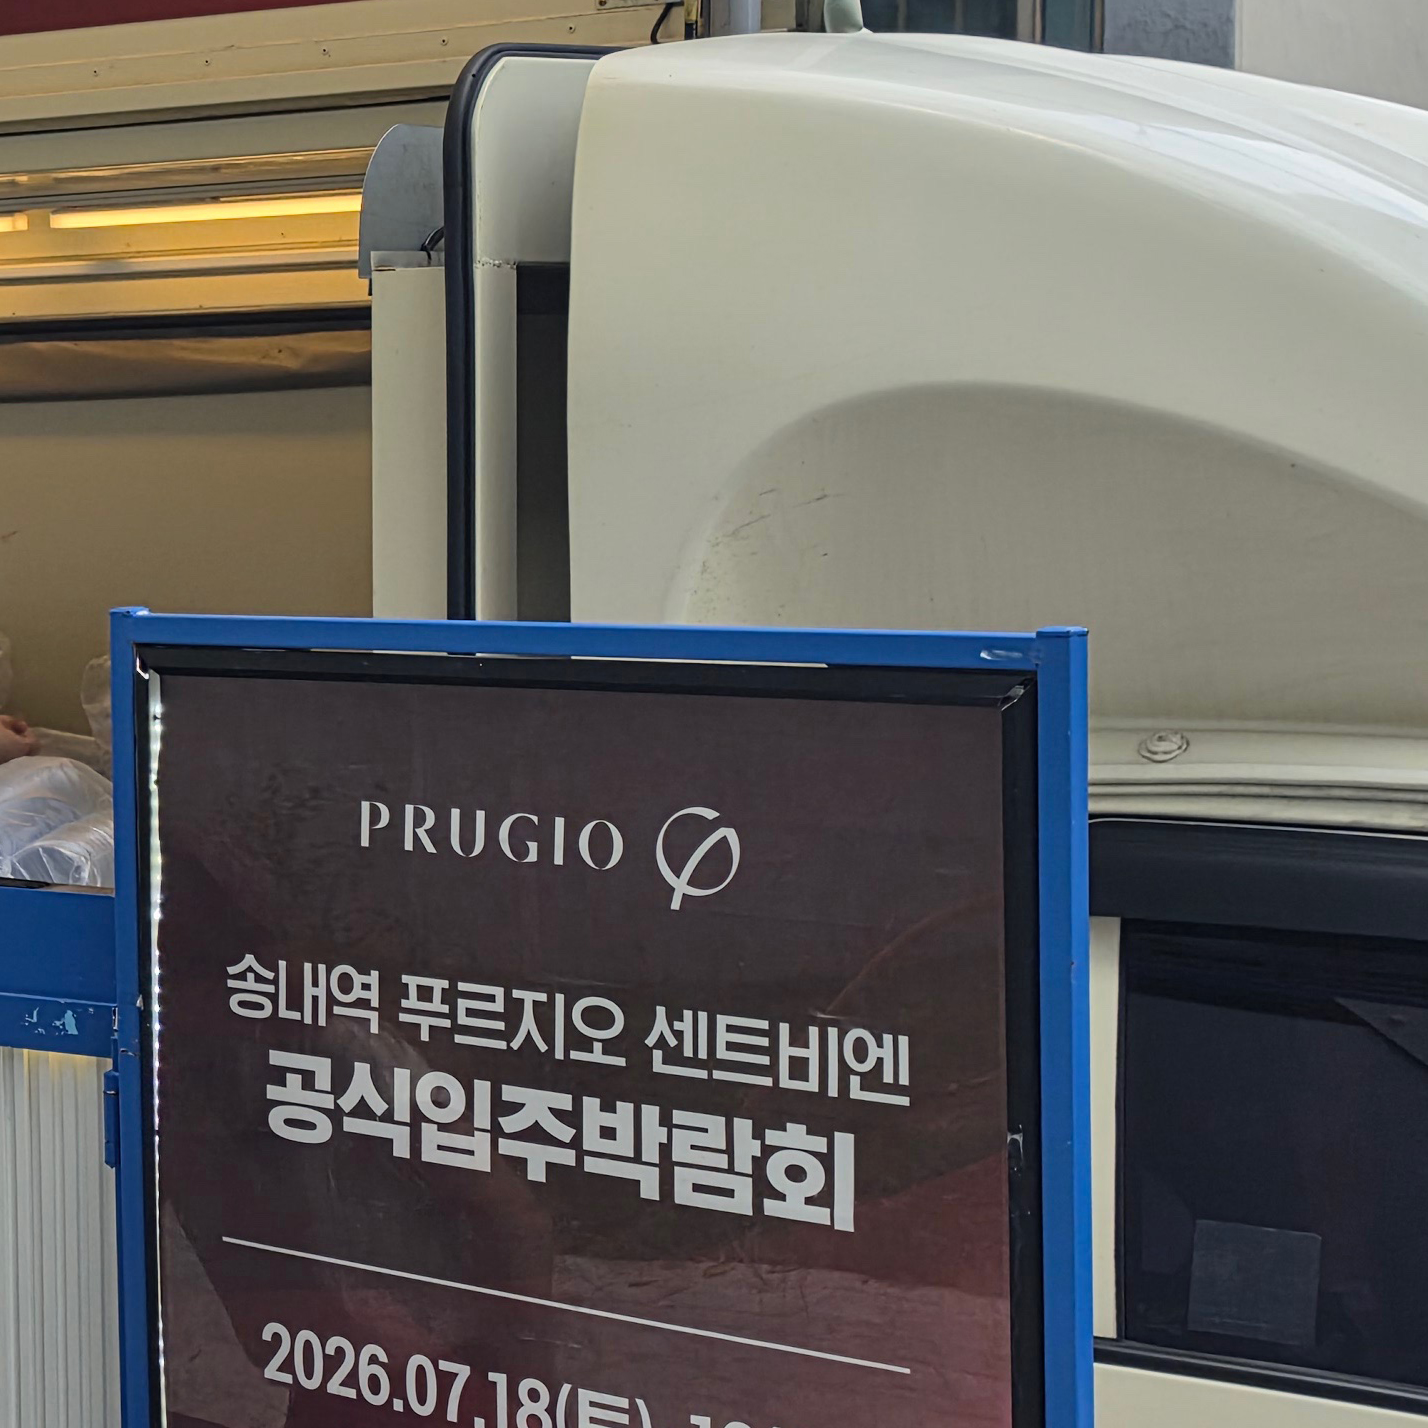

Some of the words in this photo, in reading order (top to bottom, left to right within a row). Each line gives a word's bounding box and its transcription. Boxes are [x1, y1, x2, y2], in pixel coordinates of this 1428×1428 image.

[361, 801, 623, 870] PRUGIO
[227, 954, 379, 1034] 송내역
[399, 975, 626, 1066] 푸르지오
[645, 1006, 910, 1106] 센트비엔
[265, 1049, 857, 1234] 공식입주박람회
